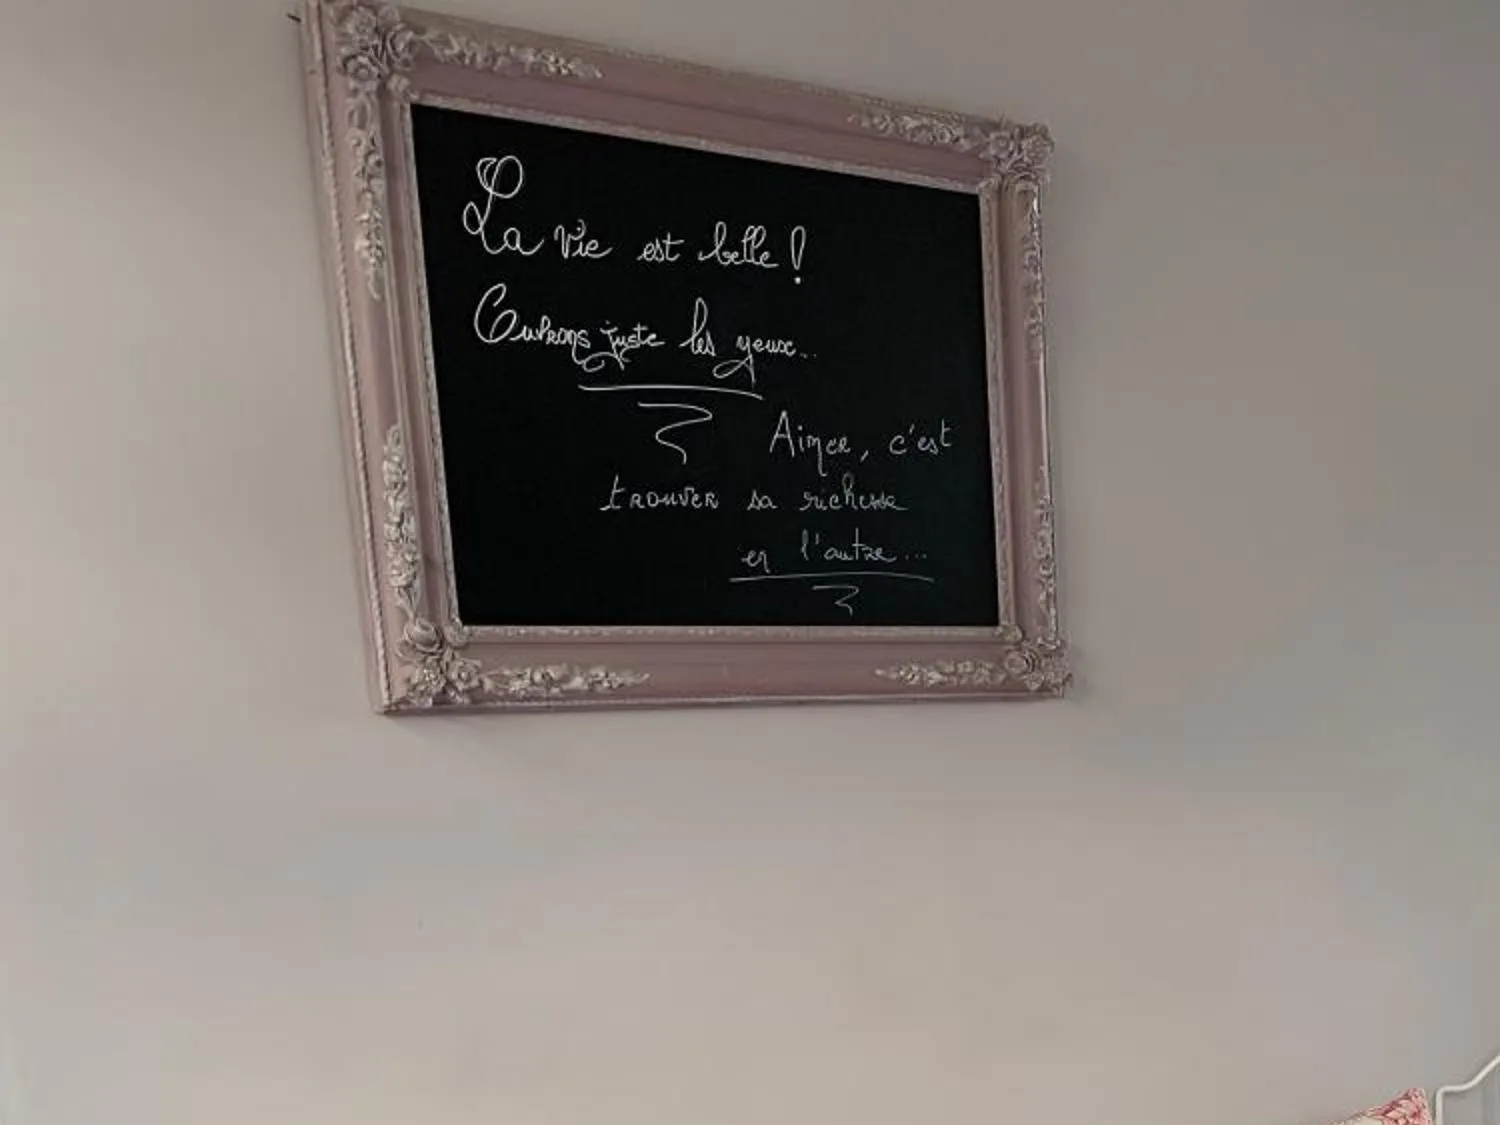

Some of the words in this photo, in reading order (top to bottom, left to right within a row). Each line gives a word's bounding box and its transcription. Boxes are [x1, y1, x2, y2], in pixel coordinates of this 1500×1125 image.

[462, 154, 546, 256] La
[636, 232, 686, 263] est
[698, 220, 780, 269] belle
[599, 320, 666, 371] juste
[679, 297, 717, 357] les
[888, 418, 954, 457] c'est
[600, 473, 720, 512] trouver
[746, 488, 779, 512] sa
[799, 471, 909, 512] richesse
[740, 549, 772, 574] en
